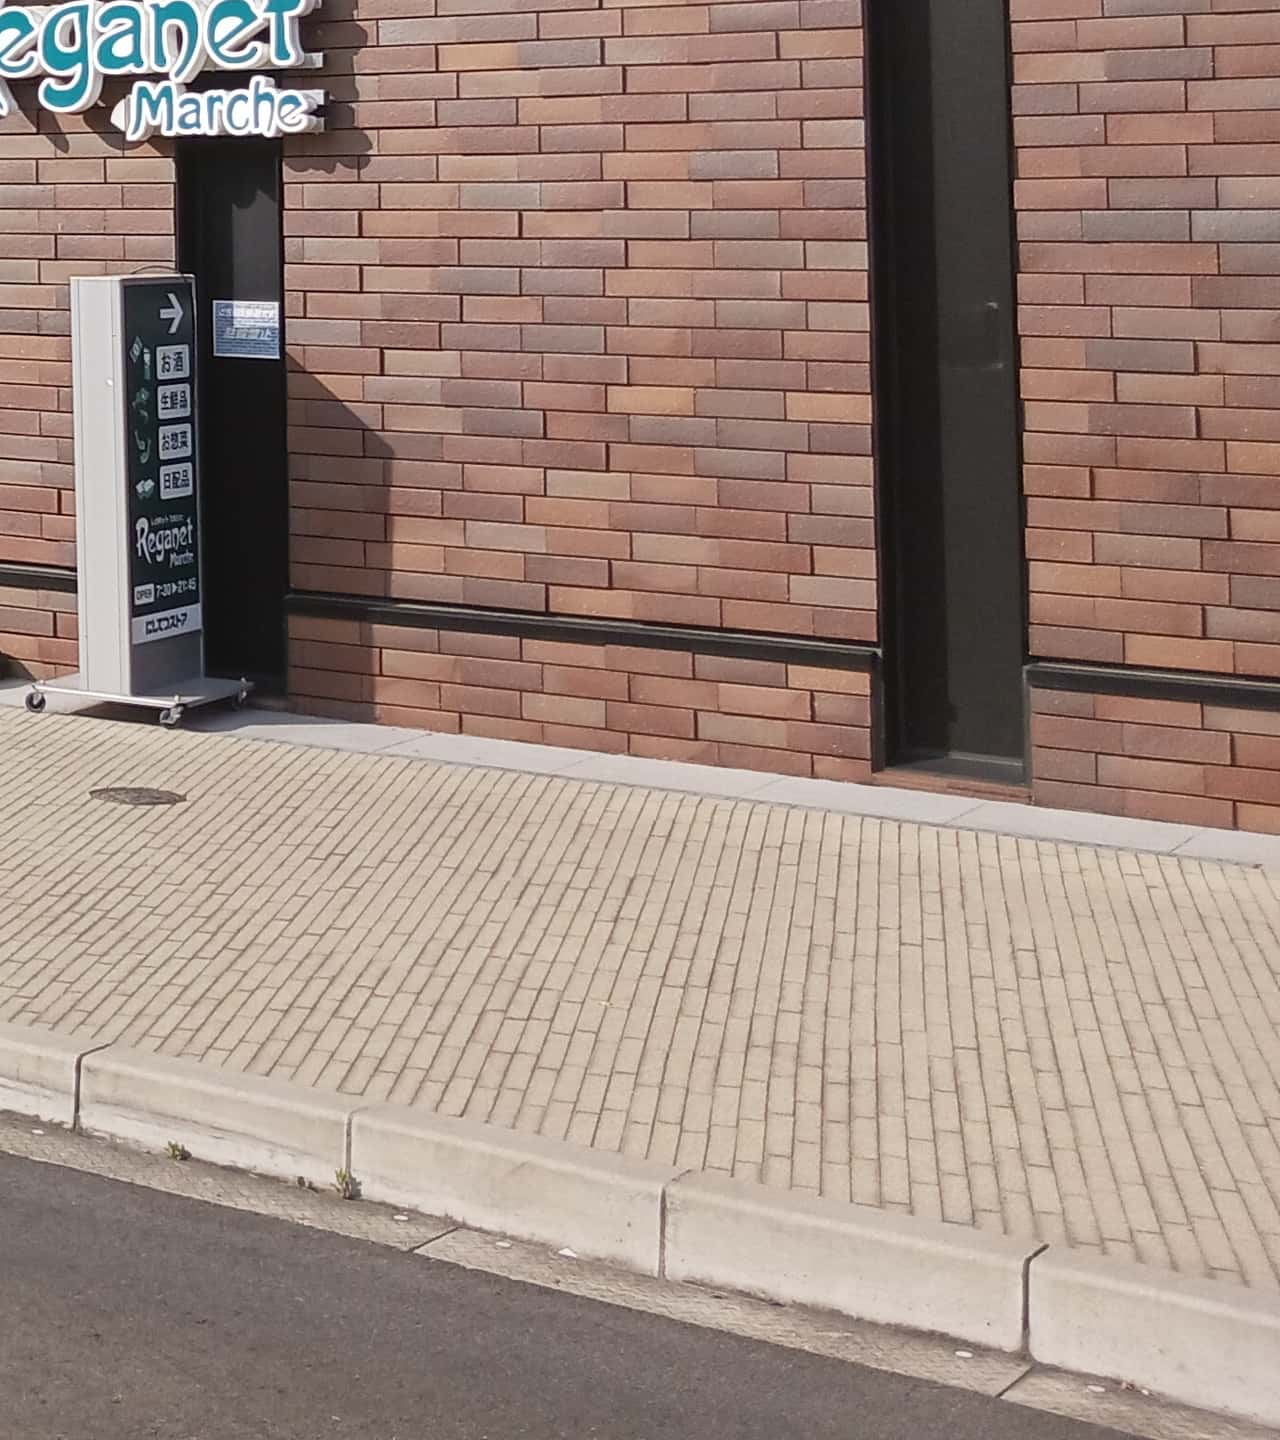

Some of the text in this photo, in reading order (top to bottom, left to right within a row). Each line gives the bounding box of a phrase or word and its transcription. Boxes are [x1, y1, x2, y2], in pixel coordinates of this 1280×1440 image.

[127, 76, 307, 140] Marche
[161, 351, 184, 373] お酒
[163, 469, 190, 489] 日配品
[135, 516, 193, 565] Reganet
